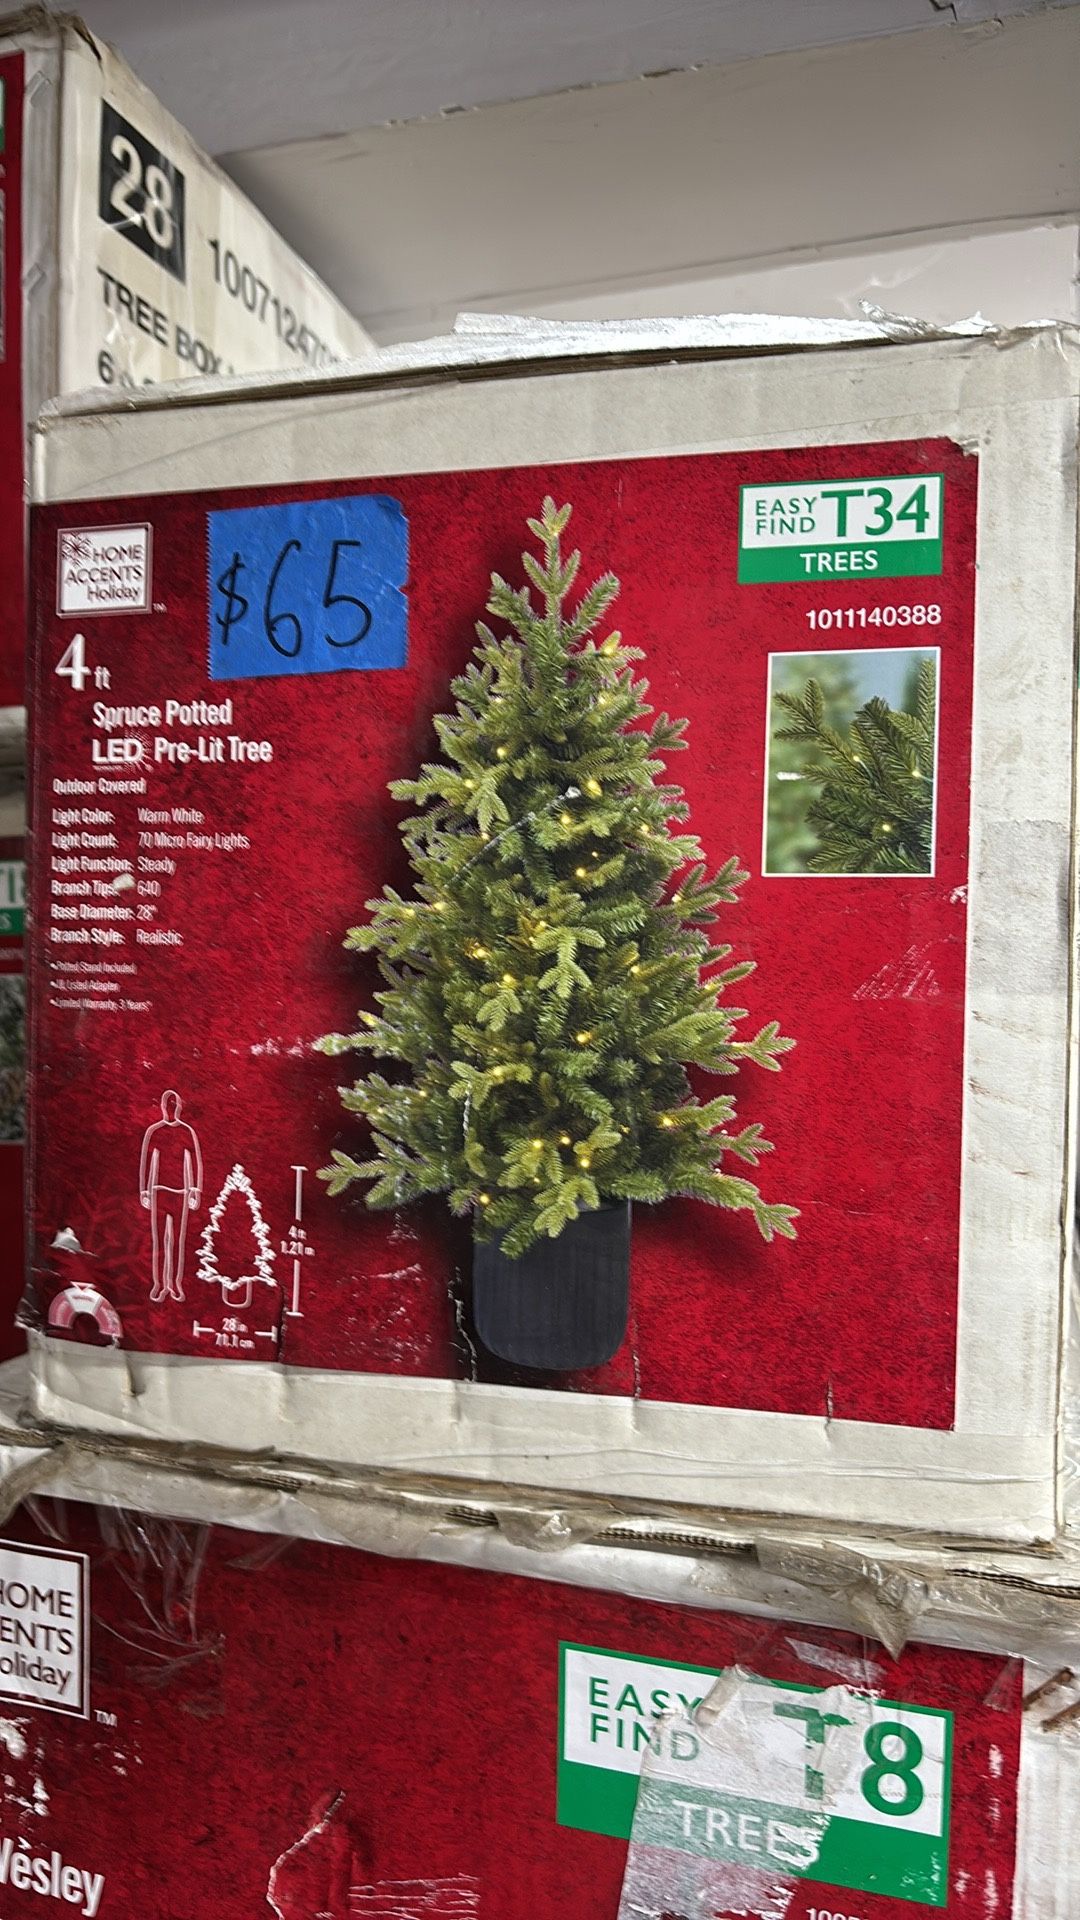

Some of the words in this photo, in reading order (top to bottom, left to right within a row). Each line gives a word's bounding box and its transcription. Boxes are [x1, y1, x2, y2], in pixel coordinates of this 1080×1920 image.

[110, 134, 174, 249] 28
[98, 267, 168, 346] TREE
[755, 497, 817, 516] EASY
[821, 484, 930, 537] T34
[756, 516, 816, 535] FIND
[93, 545, 143, 562] HOME
[800, 550, 878, 573] TREES
[66, 565, 143, 585] ACCENTS
[87, 584, 140, 602] Holiday
[216, 539, 373, 659] $65
[806, 604, 942, 630] 1011140388
[55, 634, 91, 692] 4
[94, 666, 111, 691] ft
[92, 701, 161, 732] Spruce
[166, 698, 233, 727] Potted
[92, 738, 143, 765] LED
[154, 736, 225, 764] Pre-Lit
[227, 736, 273, 763] Tree
[53, 778, 96, 796] Outdoor
[98, 777, 147, 795] Covered
[52, 808, 81, 827] Light
[137, 808, 171, 824] Warm
[171, 808, 204, 824] White
[52, 832, 81, 851] Light
[138, 832, 153, 848] 70
[154, 832, 186, 849] Micro
[186, 832, 213, 852] Fairy
[214, 833, 250, 852] Lights
[51, 856, 80, 875] Light
[137, 856, 176, 876] Steady
[51, 880, 92, 896] Branch
[137, 881, 161, 897] 640
[51, 904, 78, 919] Base
[50, 927, 91, 943] Branch
[136, 928, 184, 946] Realistic
[222, 1317, 238, 1332] 28
[589, 1676, 702, 1722] EASY
[590, 1712, 700, 1762] FIND
[671, 1798, 821, 1868] TREES
